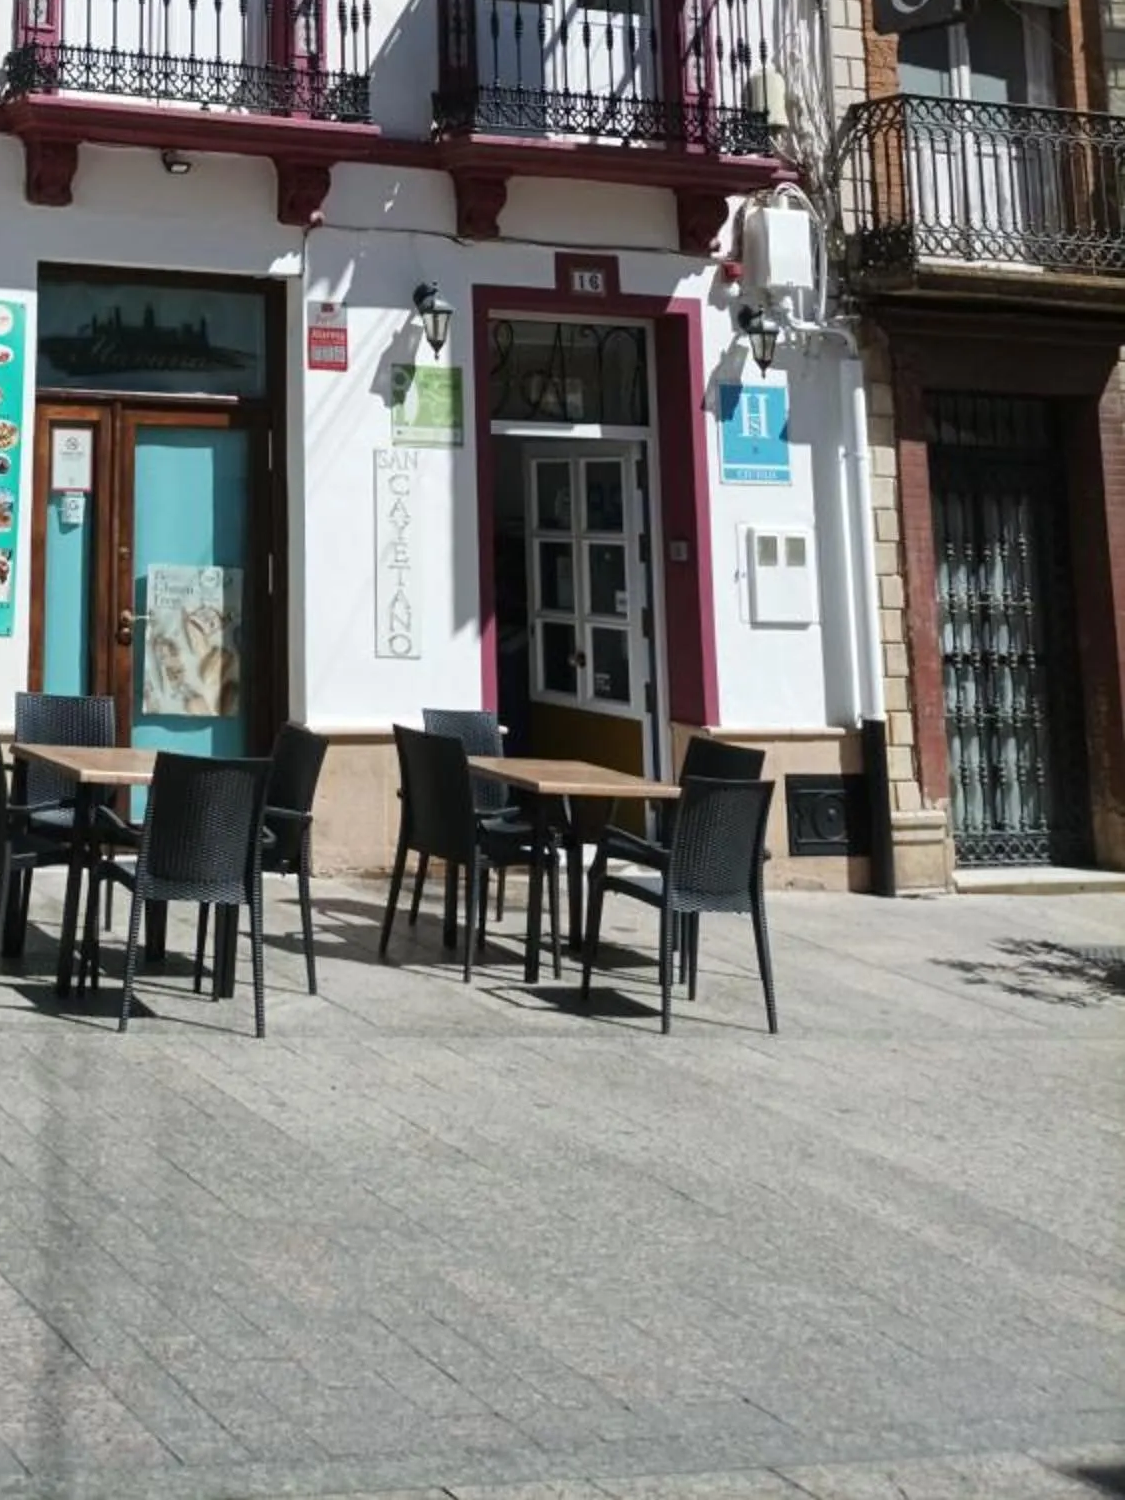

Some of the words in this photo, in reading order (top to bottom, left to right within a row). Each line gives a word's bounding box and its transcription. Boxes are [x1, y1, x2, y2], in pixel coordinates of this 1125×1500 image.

[578, 275, 600, 290] 16
[378, 450, 418, 470] SAN
[387, 473, 413, 657] CAYETANO
